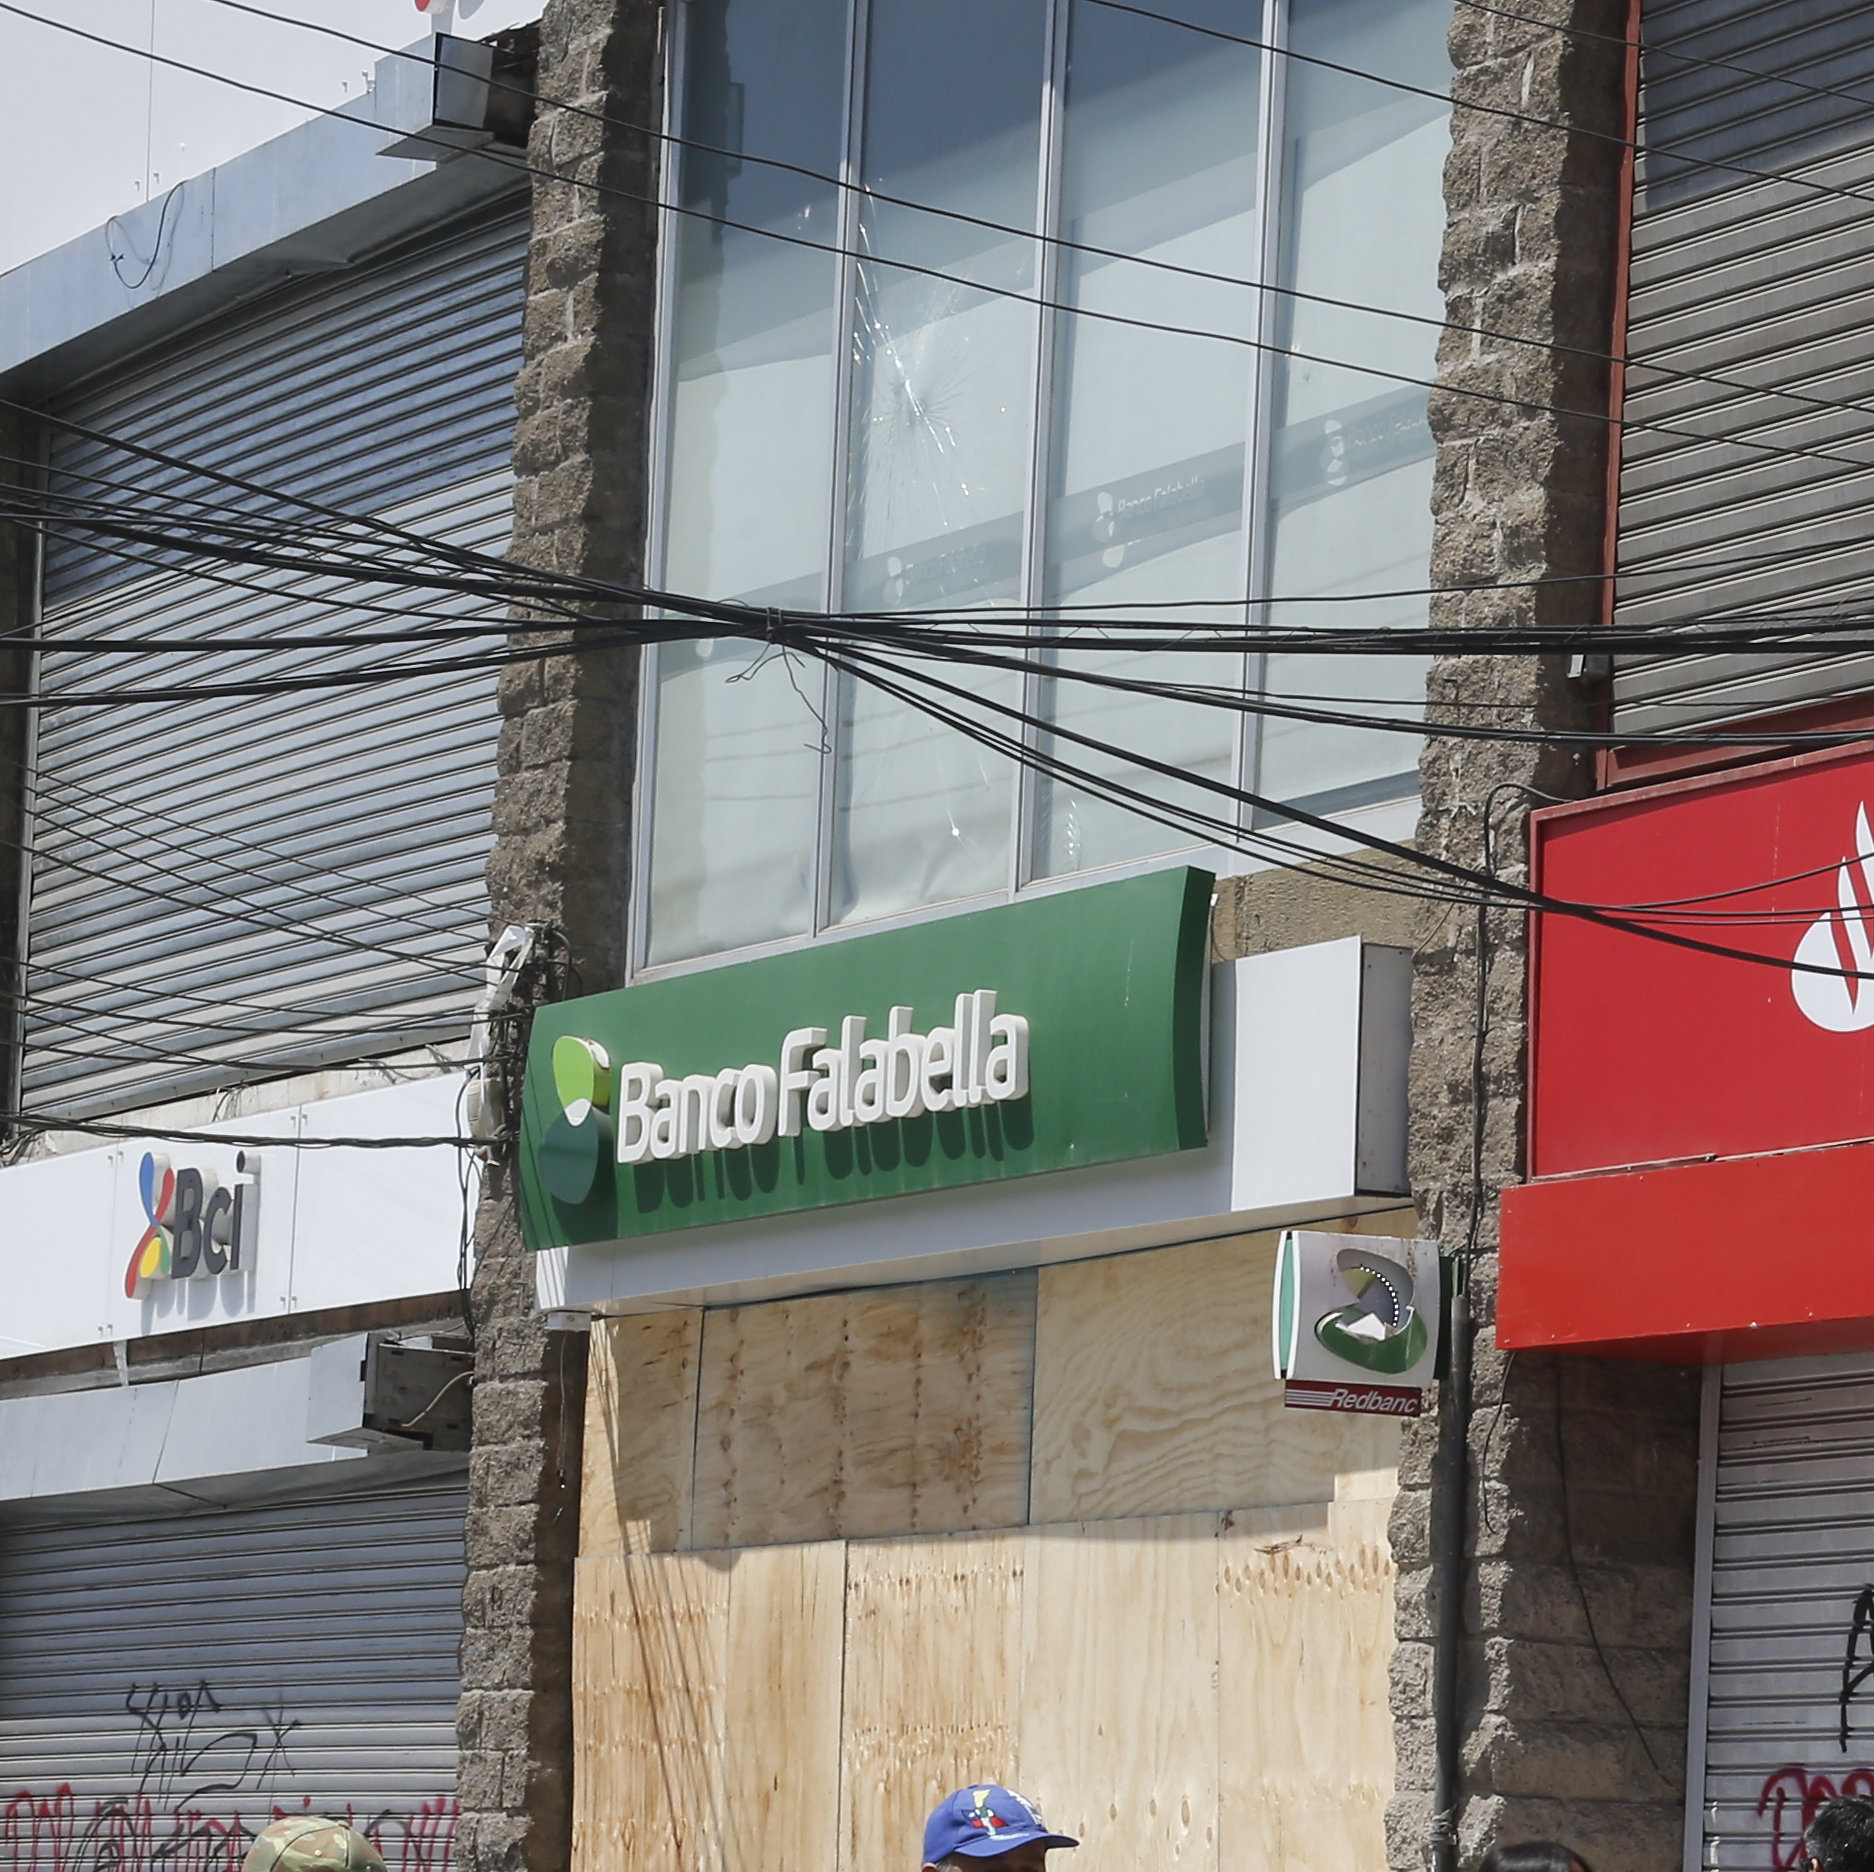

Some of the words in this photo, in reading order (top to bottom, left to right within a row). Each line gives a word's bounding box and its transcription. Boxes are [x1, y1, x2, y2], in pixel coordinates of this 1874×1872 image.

[617, 1062, 777, 1164] Banco
[777, 989, 1030, 1137] Falabella
[170, 1150, 248, 1279] Bci
[1330, 1388, 1418, 1413] Redbanc
